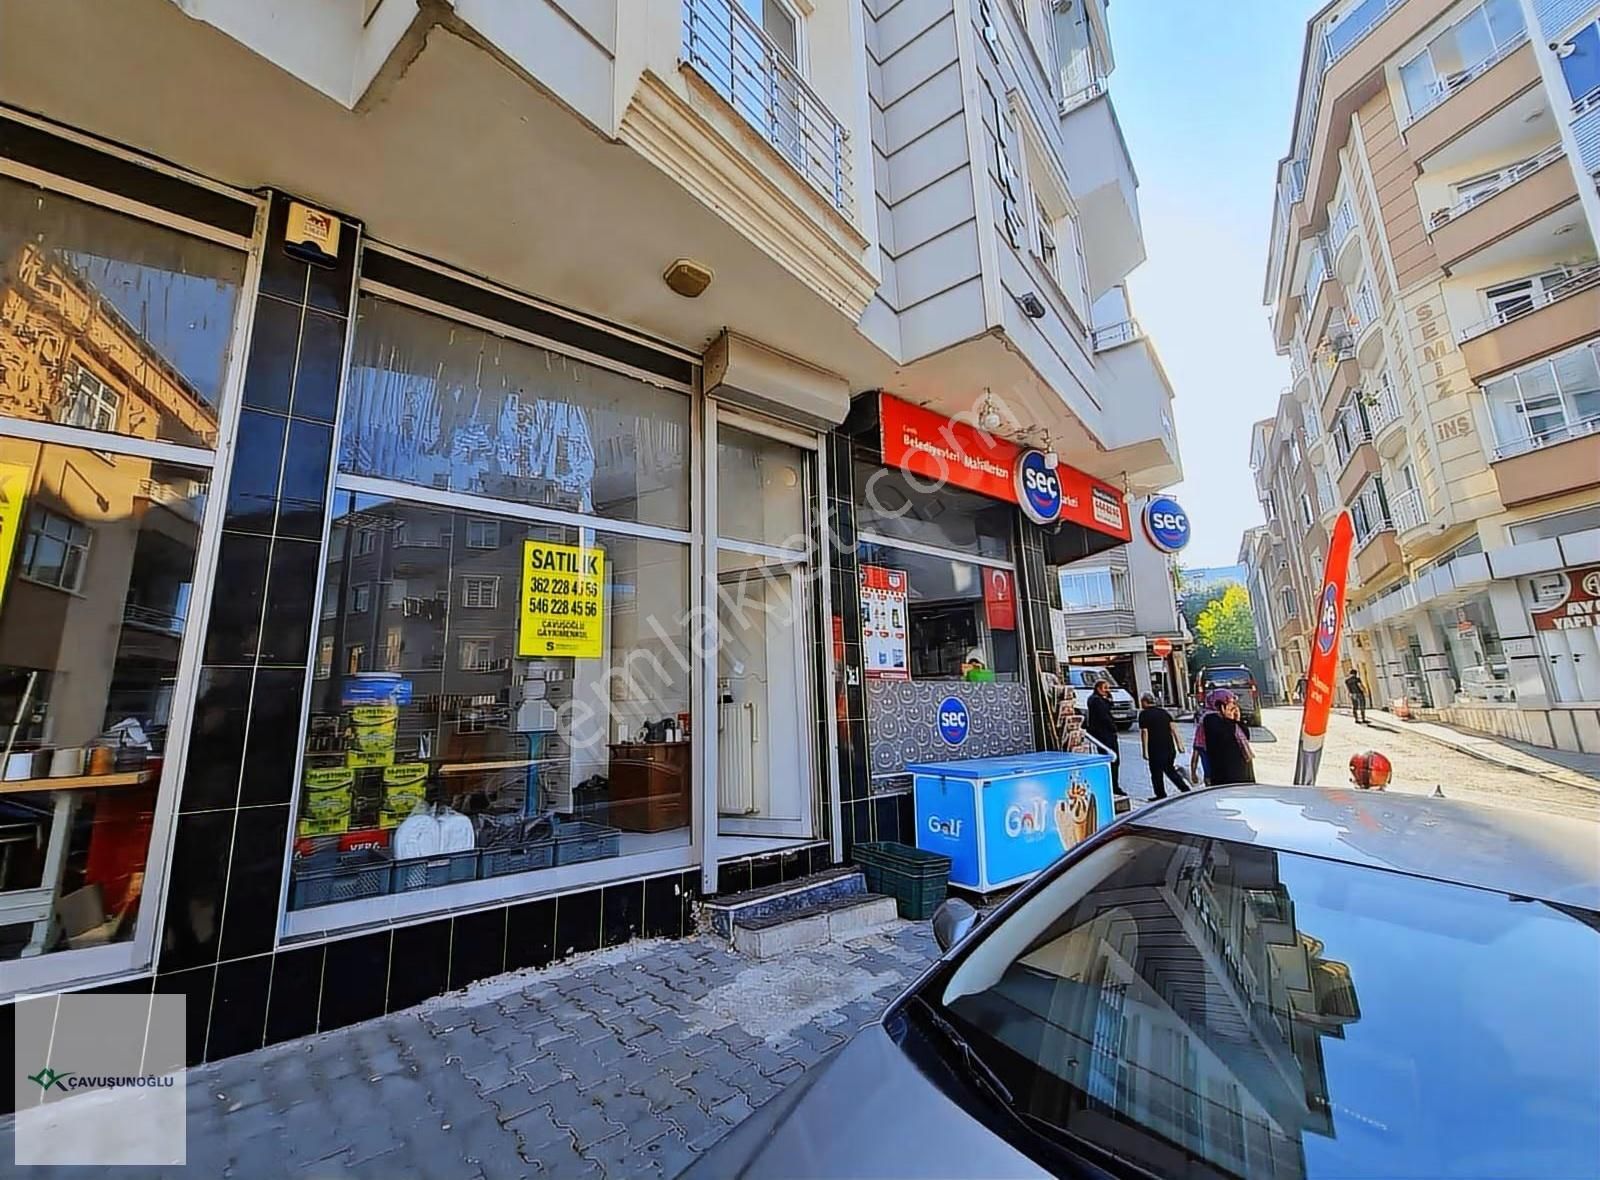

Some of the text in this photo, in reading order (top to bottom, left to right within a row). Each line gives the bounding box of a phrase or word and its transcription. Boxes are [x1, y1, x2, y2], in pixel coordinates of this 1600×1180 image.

[1025, 467, 1057, 499] seç
[1153, 511, 1187, 532] seç
[531, 548, 598, 576] SATILIK
[530, 576, 549, 594] 362
[551, 578, 570, 595] 228
[529, 596, 597, 617] 546 228 45 56
[1552, 614, 1593, 630] YAPI
